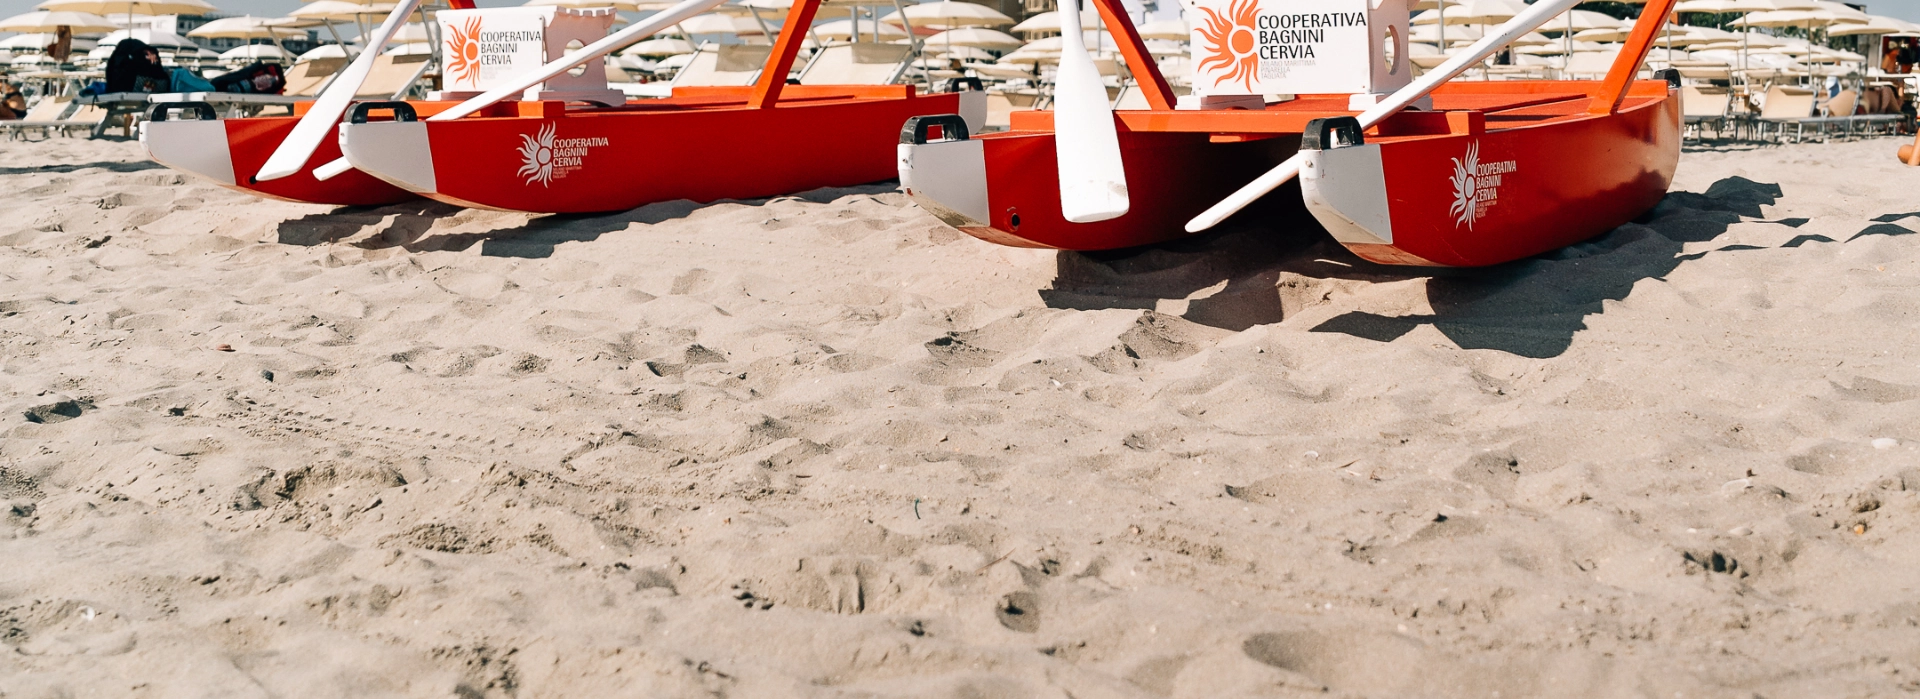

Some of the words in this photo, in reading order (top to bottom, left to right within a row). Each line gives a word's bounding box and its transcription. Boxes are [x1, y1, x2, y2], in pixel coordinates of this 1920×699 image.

[1259, 12, 1366, 29] COOPERATIVA
[481, 31, 541, 42] COOPERATIVA
[1260, 29, 1323, 44] BAGNINI
[481, 43, 517, 53] BAGNINI
[1260, 45, 1315, 59] CERVIA
[481, 55, 511, 65] CERVIA
[553, 137, 609, 148] COOPERATIVA
[553, 148, 588, 157] BAGNINI
[552, 157, 582, 167] CERVIA
[1476, 160, 1517, 176] COOPERATIVA
[1476, 175, 1502, 189] BAGNINI
[1475, 187, 1497, 202] CERVIA
